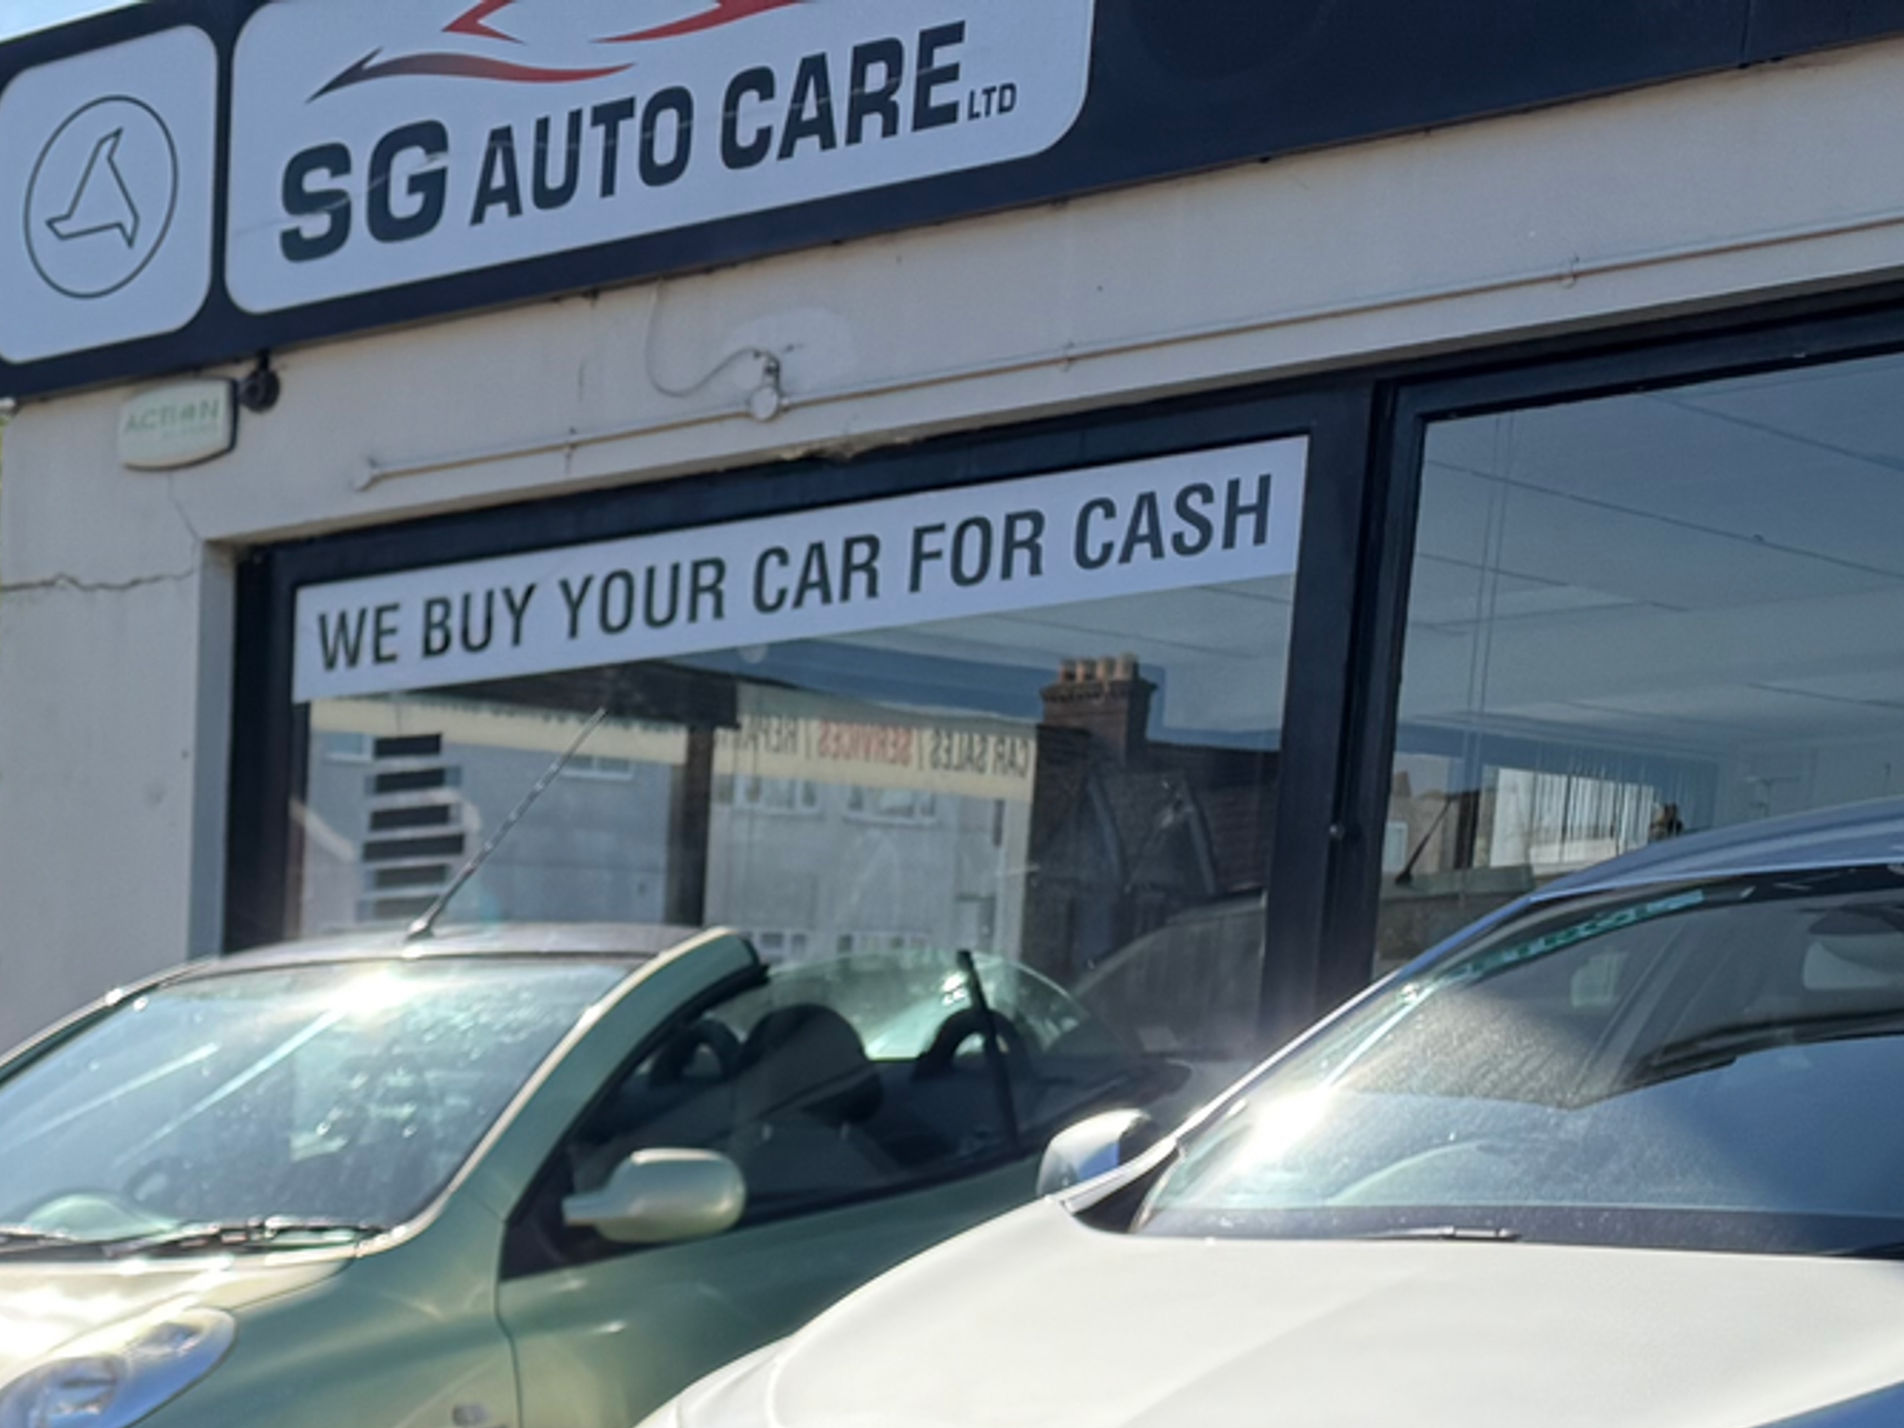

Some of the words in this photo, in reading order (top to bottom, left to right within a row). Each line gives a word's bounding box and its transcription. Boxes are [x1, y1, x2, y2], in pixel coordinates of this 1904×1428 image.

[279, 119, 449, 262] SG
[470, 86, 694, 225] AUTO
[720, 20, 967, 170] CARE
[967, 82, 1017, 121] LTD
[318, 602, 399, 671] WE
[422, 584, 537, 658] BUY
[558, 558, 727, 636] YOUR
[752, 534, 880, 612] CAR
[908, 510, 1044, 591] FOR
[1074, 474, 1273, 571] CASH
